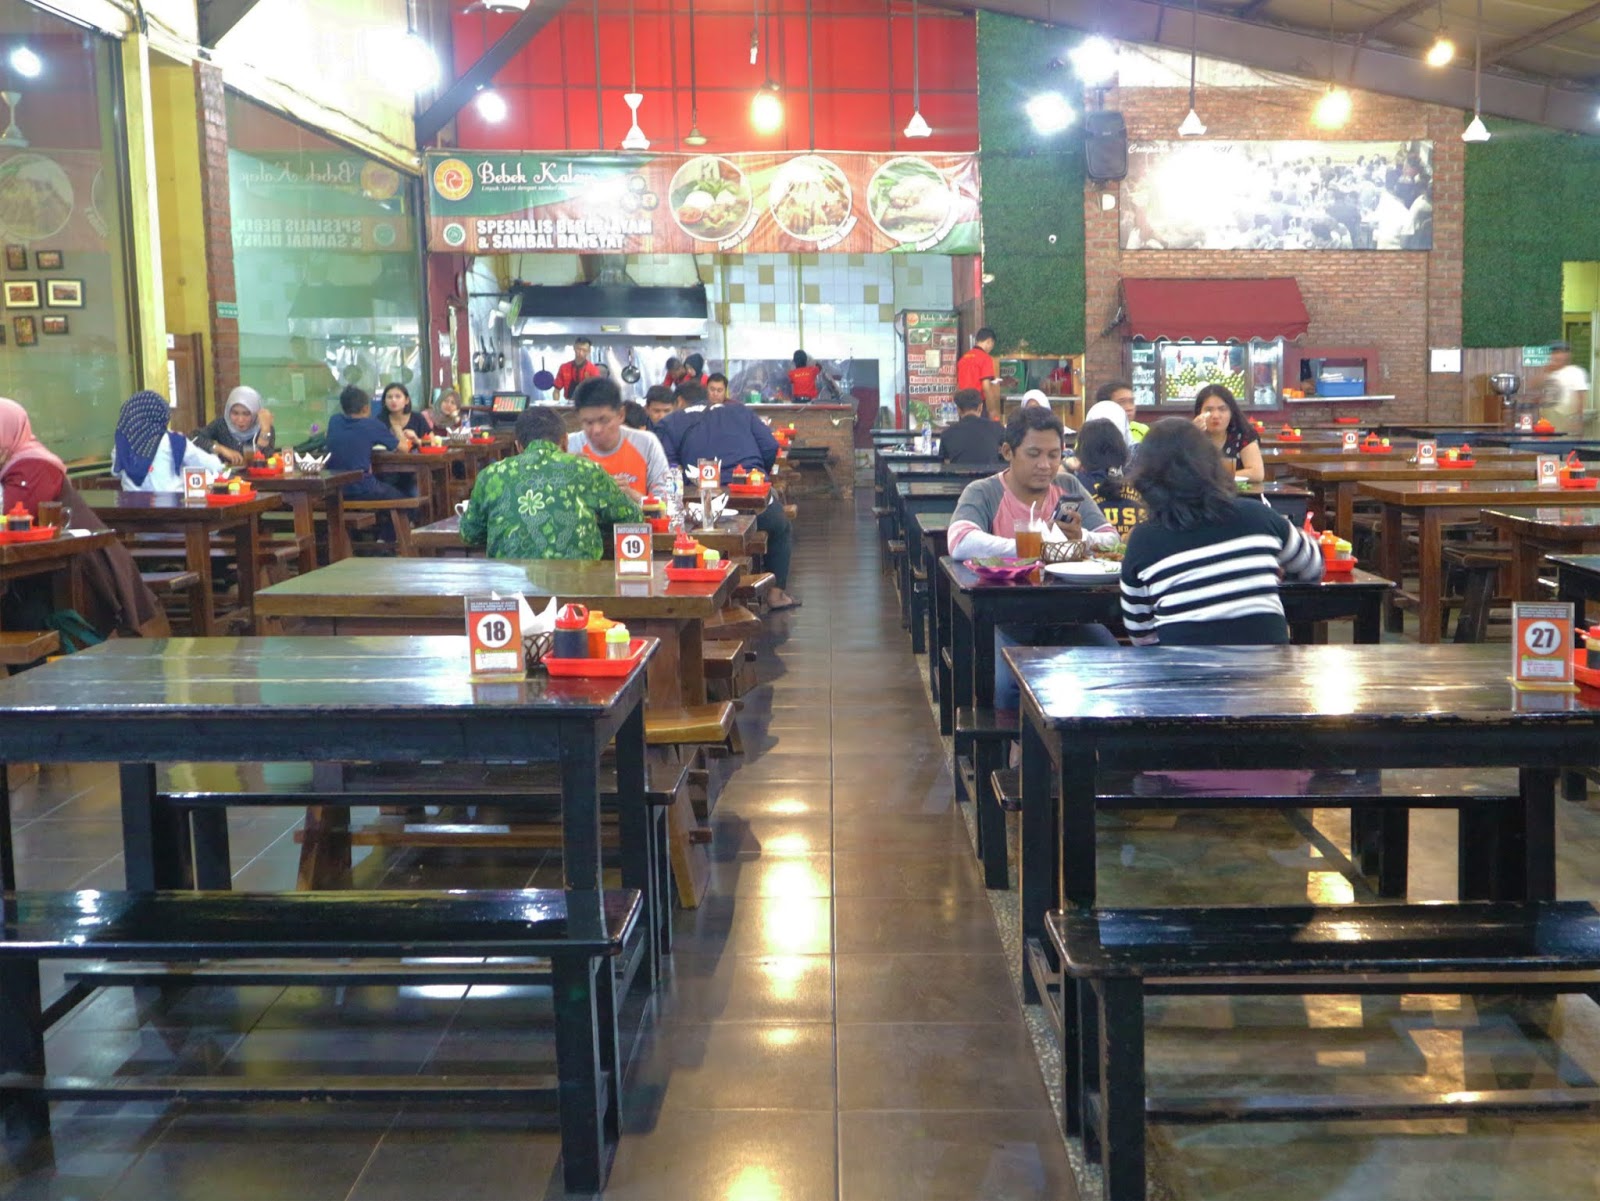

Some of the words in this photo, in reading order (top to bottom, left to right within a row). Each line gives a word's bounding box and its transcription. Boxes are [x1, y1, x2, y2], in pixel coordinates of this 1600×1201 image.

[477, 160, 527, 184] Bebek
[476, 219, 553, 234] SPESIALIS
[477, 235, 489, 248] &
[492, 234, 554, 248] SAMBAL
[704, 466, 713, 476] 21
[192, 477, 201, 485] 13
[625, 540, 641, 554] 19
[483, 621, 506, 641] 18
[1531, 627, 1555, 648] 27
